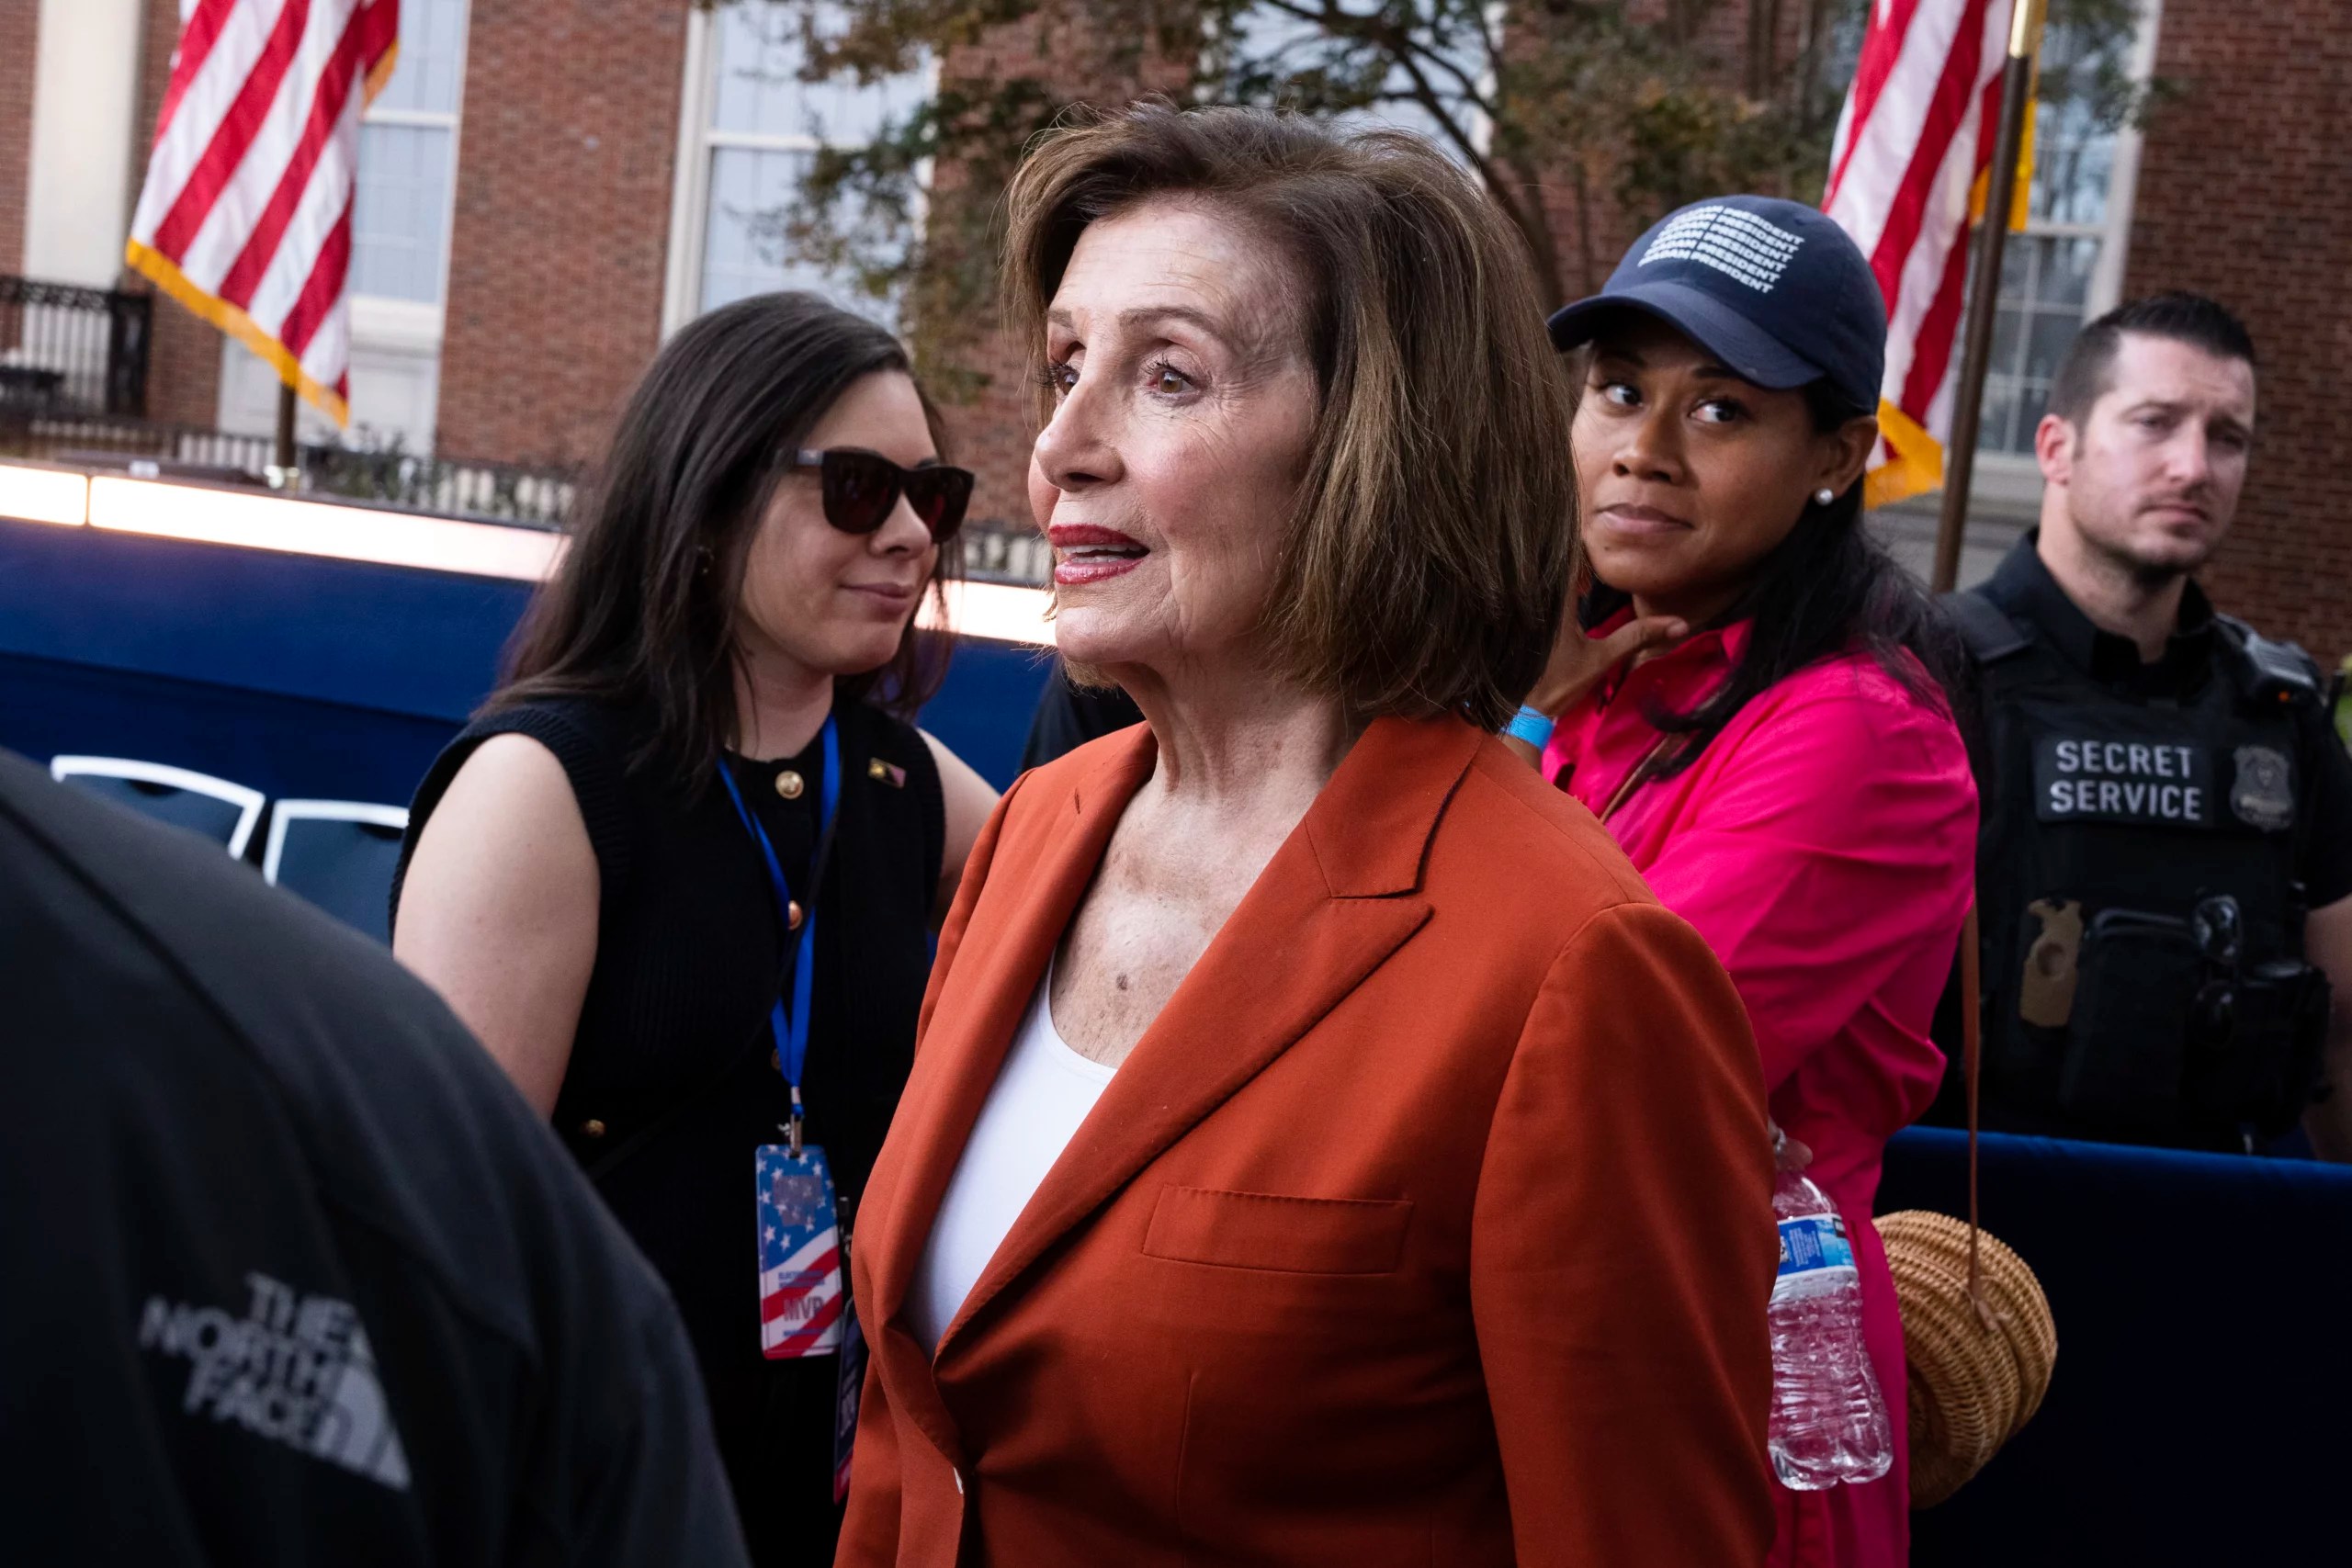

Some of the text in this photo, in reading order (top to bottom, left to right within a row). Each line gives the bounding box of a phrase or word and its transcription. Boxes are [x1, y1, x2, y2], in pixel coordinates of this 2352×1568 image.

[1709, 222, 1793, 263] PRESIDENT
[1716, 214, 1799, 254] PRESIDENT
[1723, 207, 1805, 245] PRESIDENT
[1690, 250, 1774, 293] PRESIDENT
[1696, 241, 1781, 283] PRESIDENT
[1703, 231, 1787, 273] PRESIDENT
[2055, 740, 2193, 779] SECRET
[2050, 780, 2201, 820] SERVICE
[243, 1270, 358, 1348] THE
[783, 1295, 824, 1322] MVP
[140, 1295, 340, 1401] NORTH
